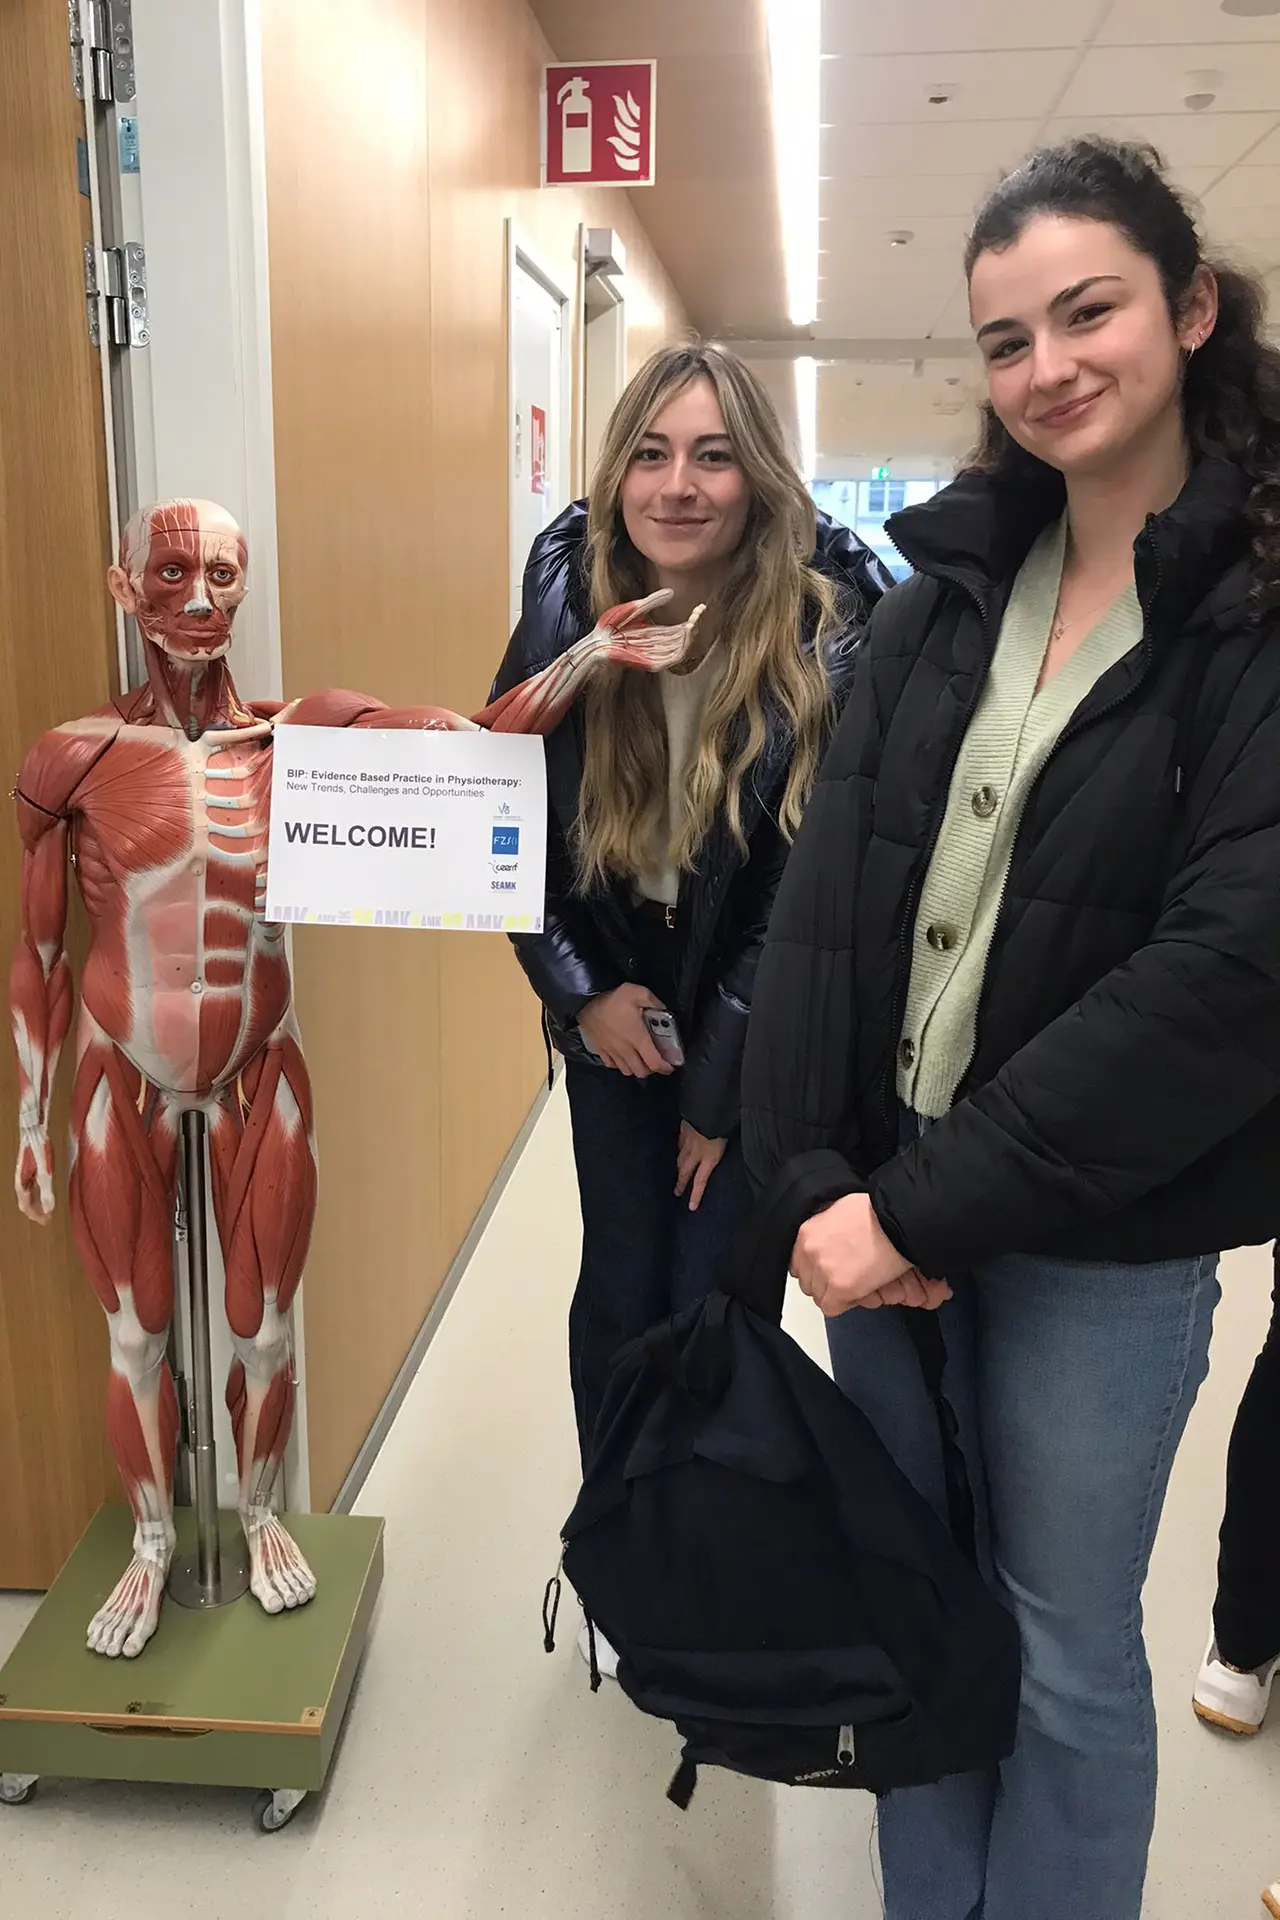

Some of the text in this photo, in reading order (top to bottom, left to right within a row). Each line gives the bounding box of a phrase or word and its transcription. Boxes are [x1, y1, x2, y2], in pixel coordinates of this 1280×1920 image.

[287, 768, 522, 788] BIP: Evidence Based Practice in Physiotherapy:
[286, 781, 485, 798] New Trends, Challenges and Opportunities
[284, 821, 436, 849] WELCOME!
[490, 880, 517, 890] SEAMK
